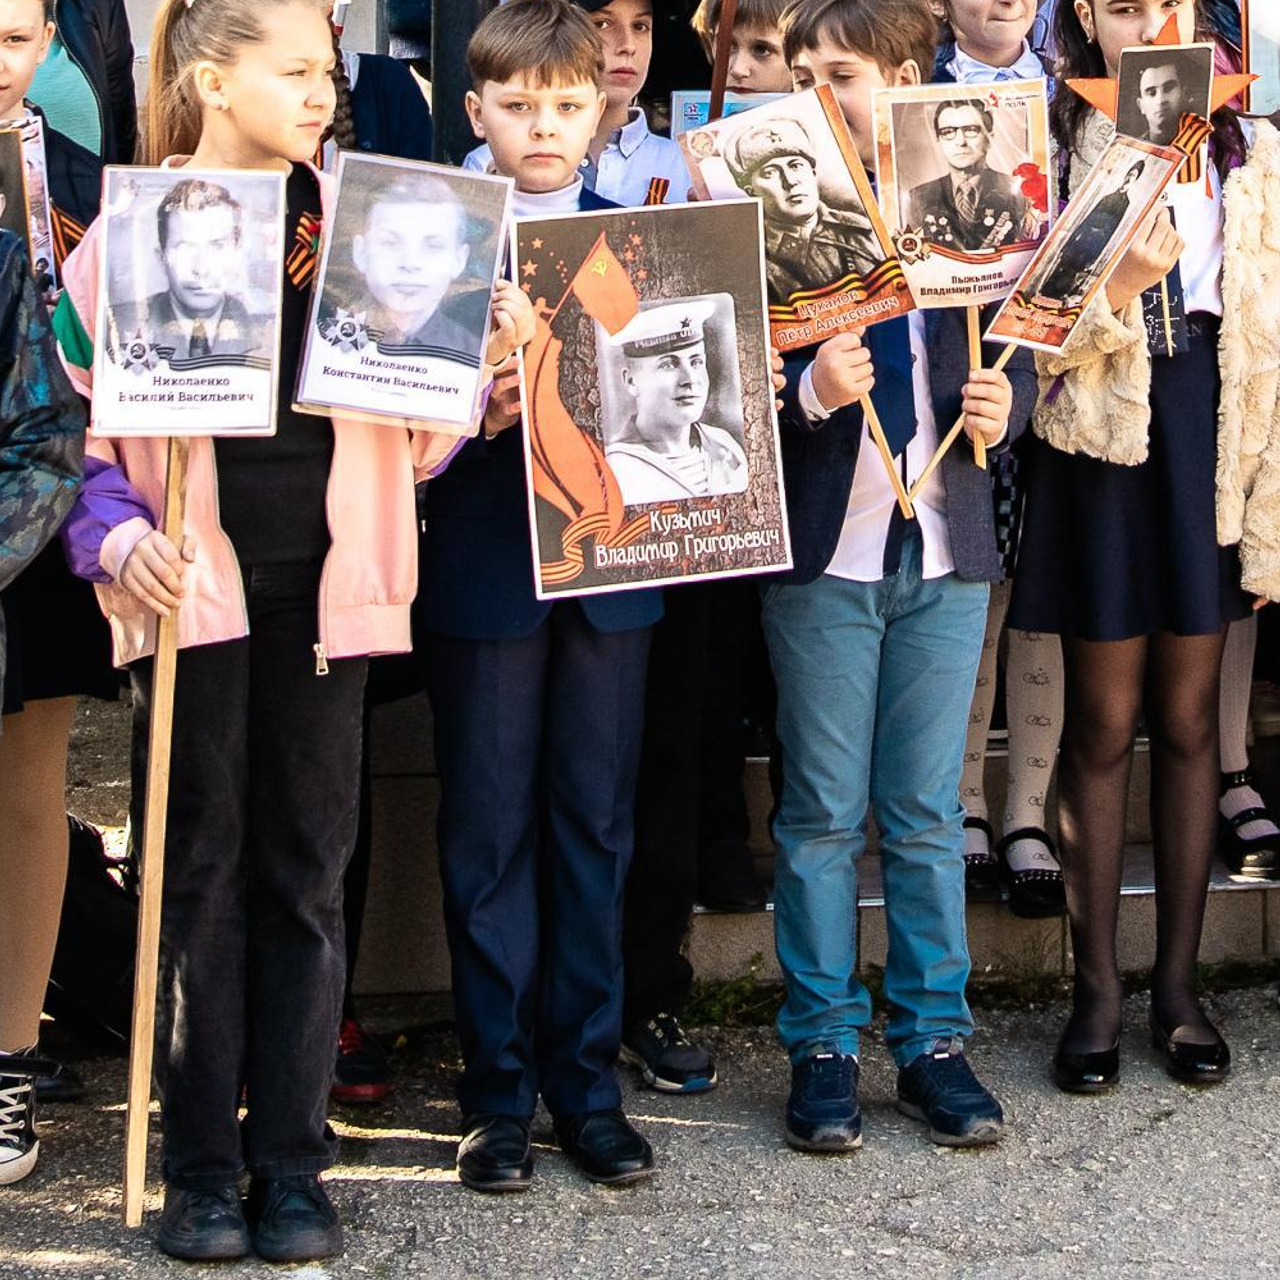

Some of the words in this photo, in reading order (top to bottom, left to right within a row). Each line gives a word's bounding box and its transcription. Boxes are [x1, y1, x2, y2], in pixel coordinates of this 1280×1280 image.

[951, 271, 1004, 284] Пыжьянов
[920, 285, 972, 297] Владимир
[797, 288, 860, 319] Цуканов
[815, 285, 900, 332] Алексеевич
[361, 355, 429, 376] Николаенко
[152, 374, 230, 387] Николаенко
[322, 365, 391, 385] Константин
[392, 377, 461, 396] Васильевич
[118, 389, 175, 402] Василий
[177, 390, 254, 403] Васильевич
[650, 508, 721, 535] Кузьмич
[595, 540, 679, 568] Владимир
[683, 528, 781, 560] Григорьевич
